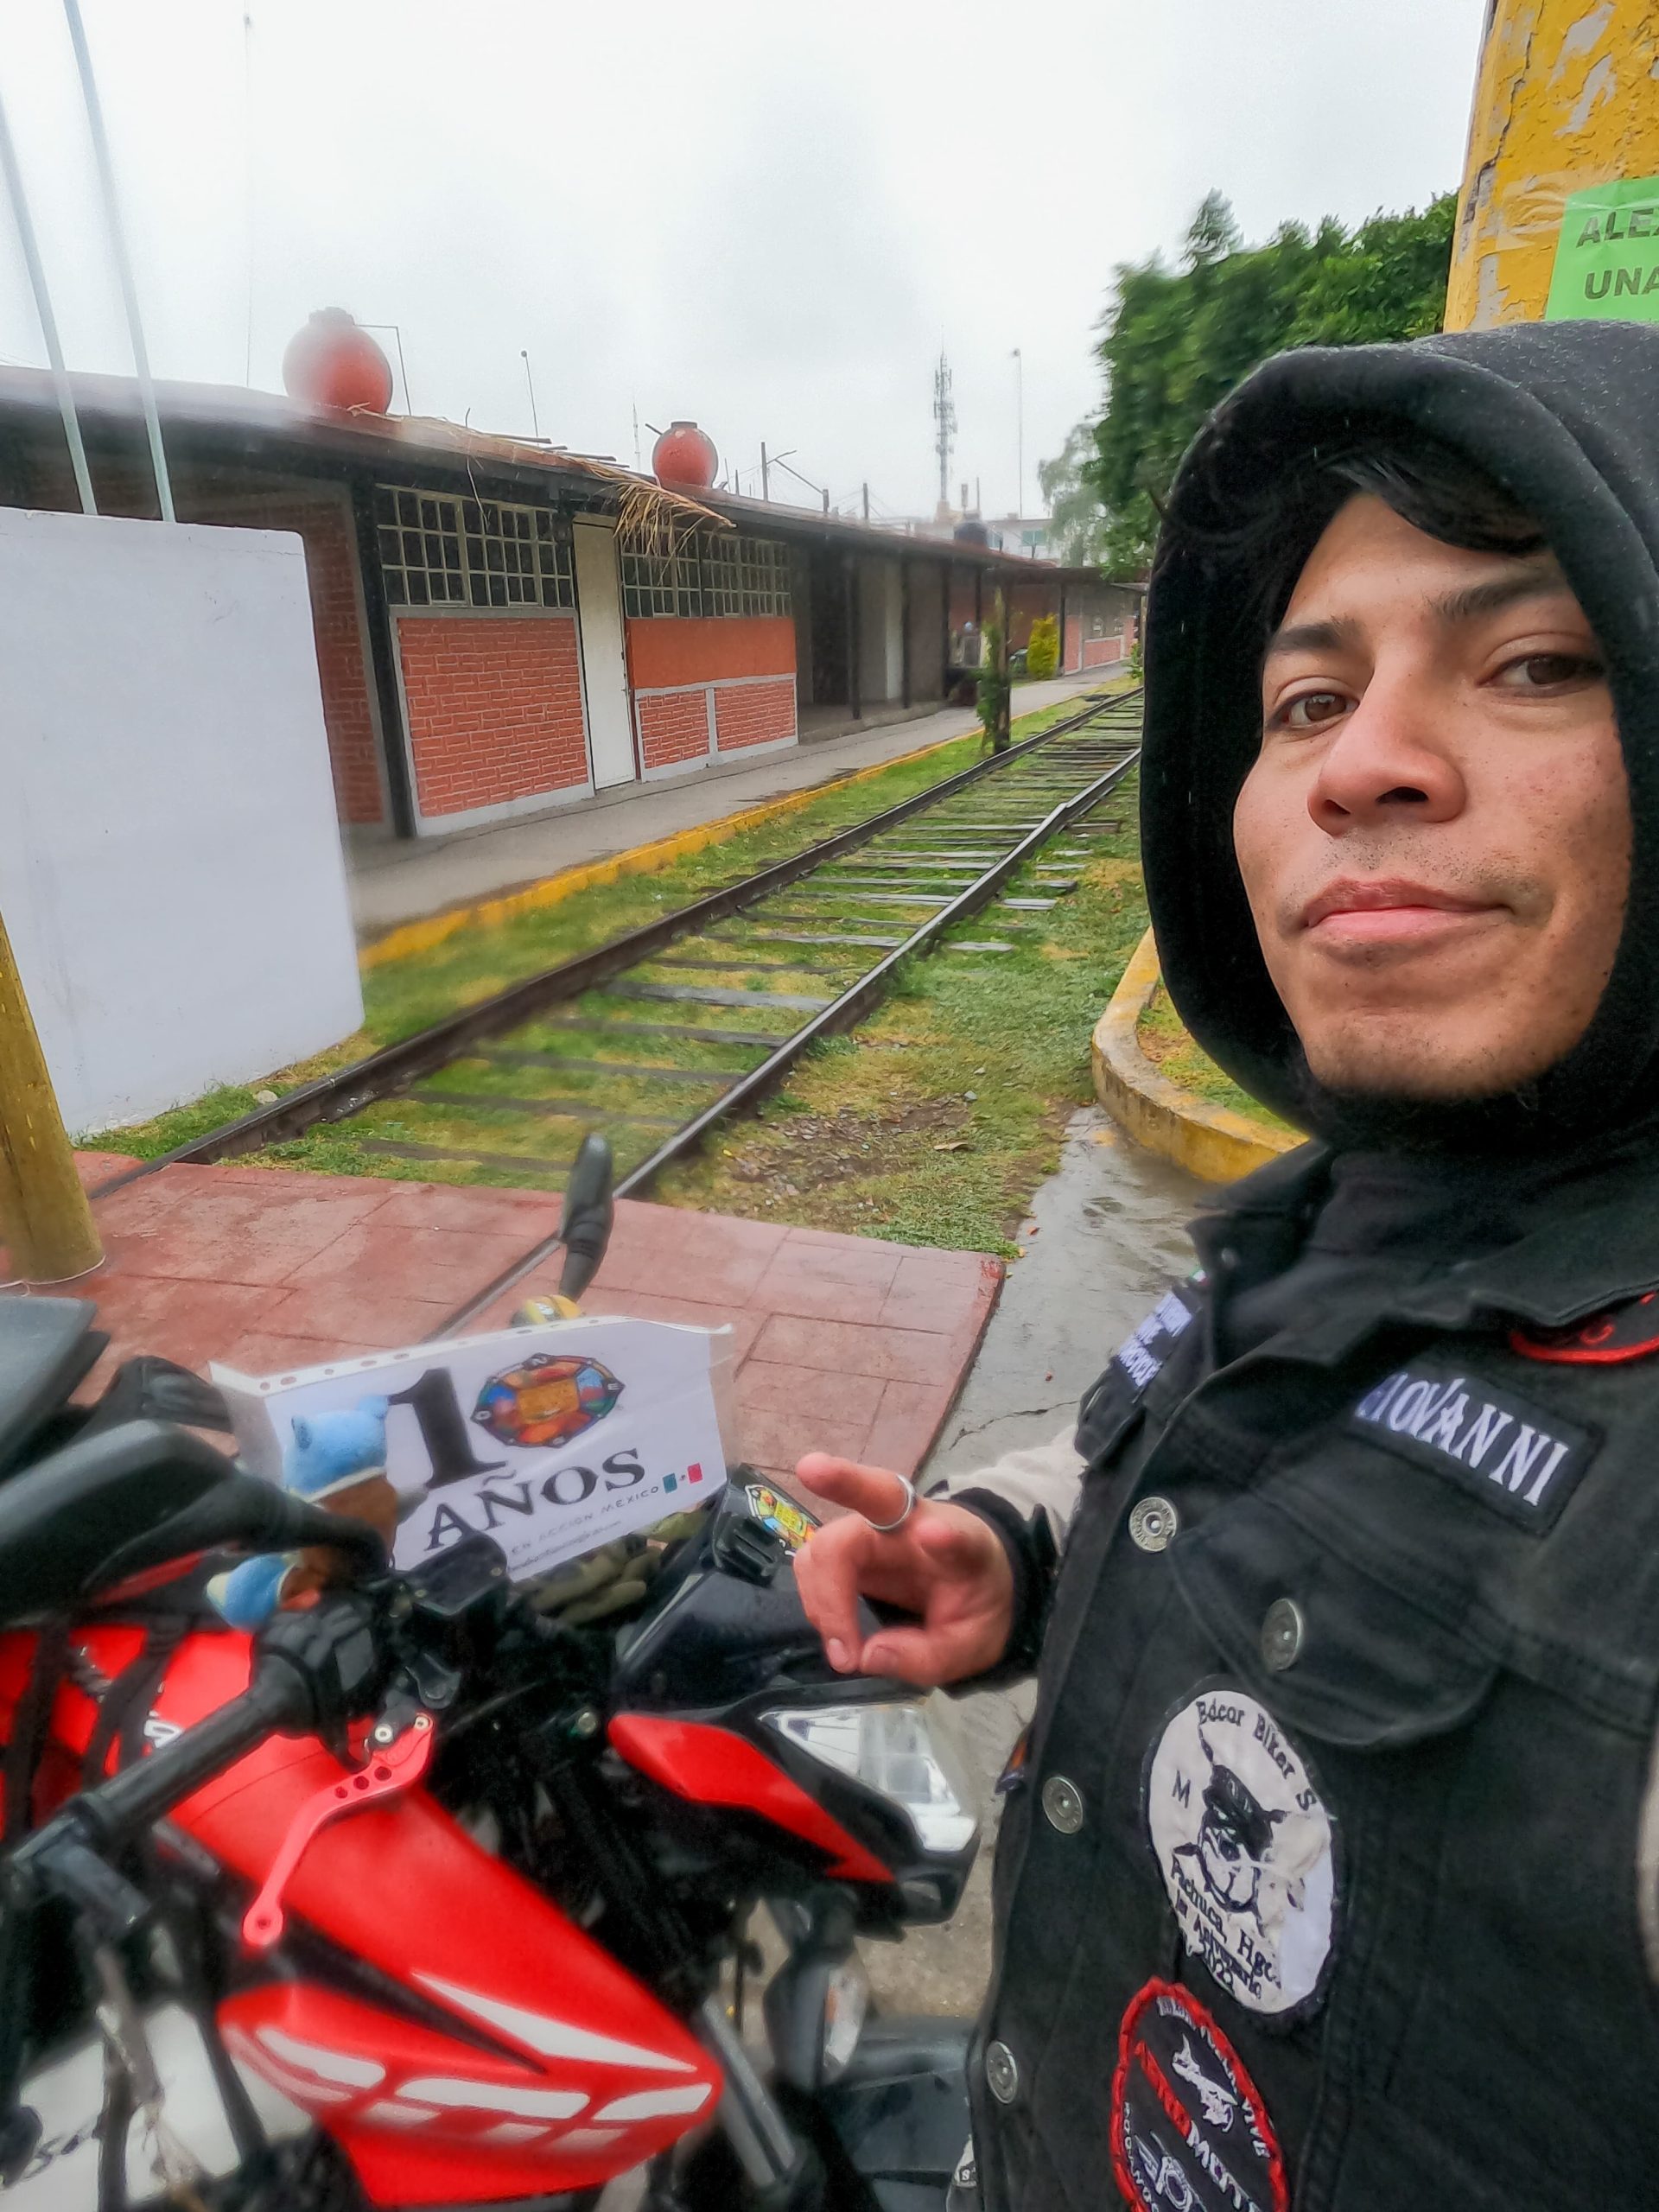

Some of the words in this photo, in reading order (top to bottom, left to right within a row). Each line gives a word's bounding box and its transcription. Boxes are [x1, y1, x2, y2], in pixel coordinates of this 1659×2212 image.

[1576, 207, 1659, 249] ALE
[423, 1447, 645, 1552] AÑOS
[1172, 1769, 1192, 1809] M
